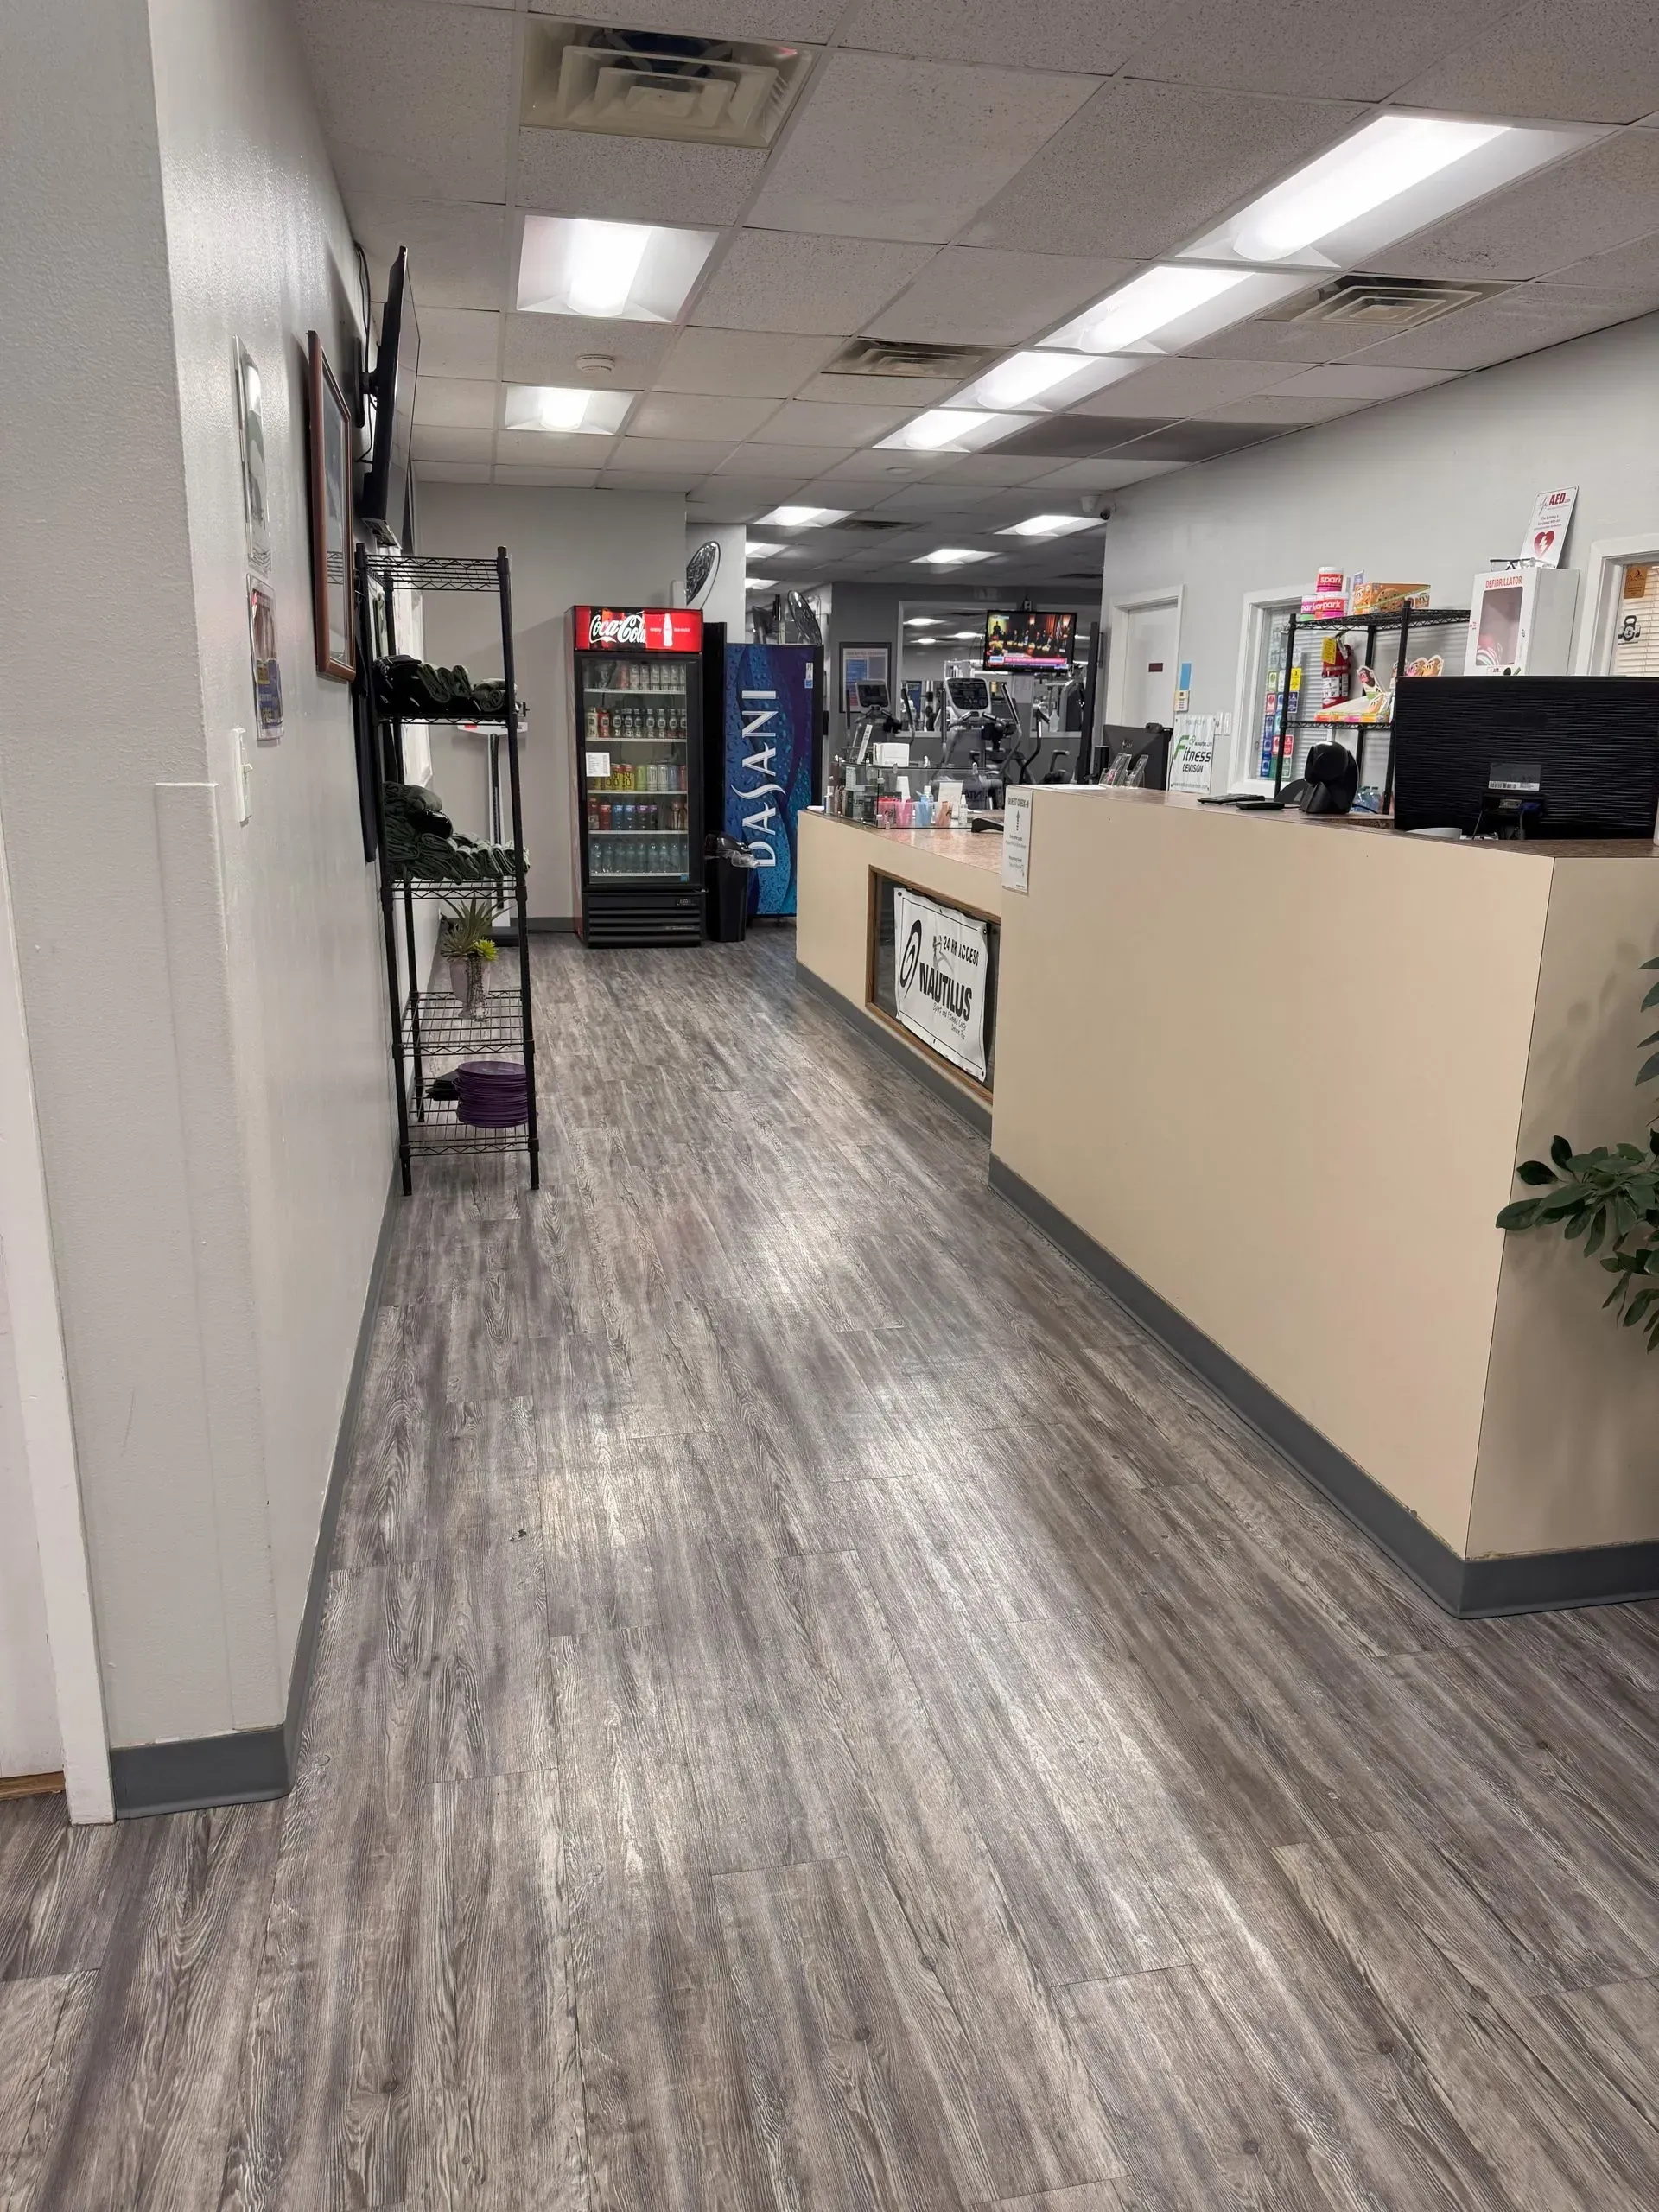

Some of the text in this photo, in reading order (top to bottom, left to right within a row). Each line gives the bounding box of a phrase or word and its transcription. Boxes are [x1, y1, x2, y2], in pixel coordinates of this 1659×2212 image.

[1549, 493, 1566, 506] AED
[1320, 575, 1342, 585] spark
[1486, 576, 1522, 588] DEFIBRILLATOR
[1174, 735, 1211, 762] Fitness
[731, 690, 786, 867] DASANI
[943, 936, 979, 967] 24 HR ACCESS
[919, 962, 973, 1021] NAUTILUS
